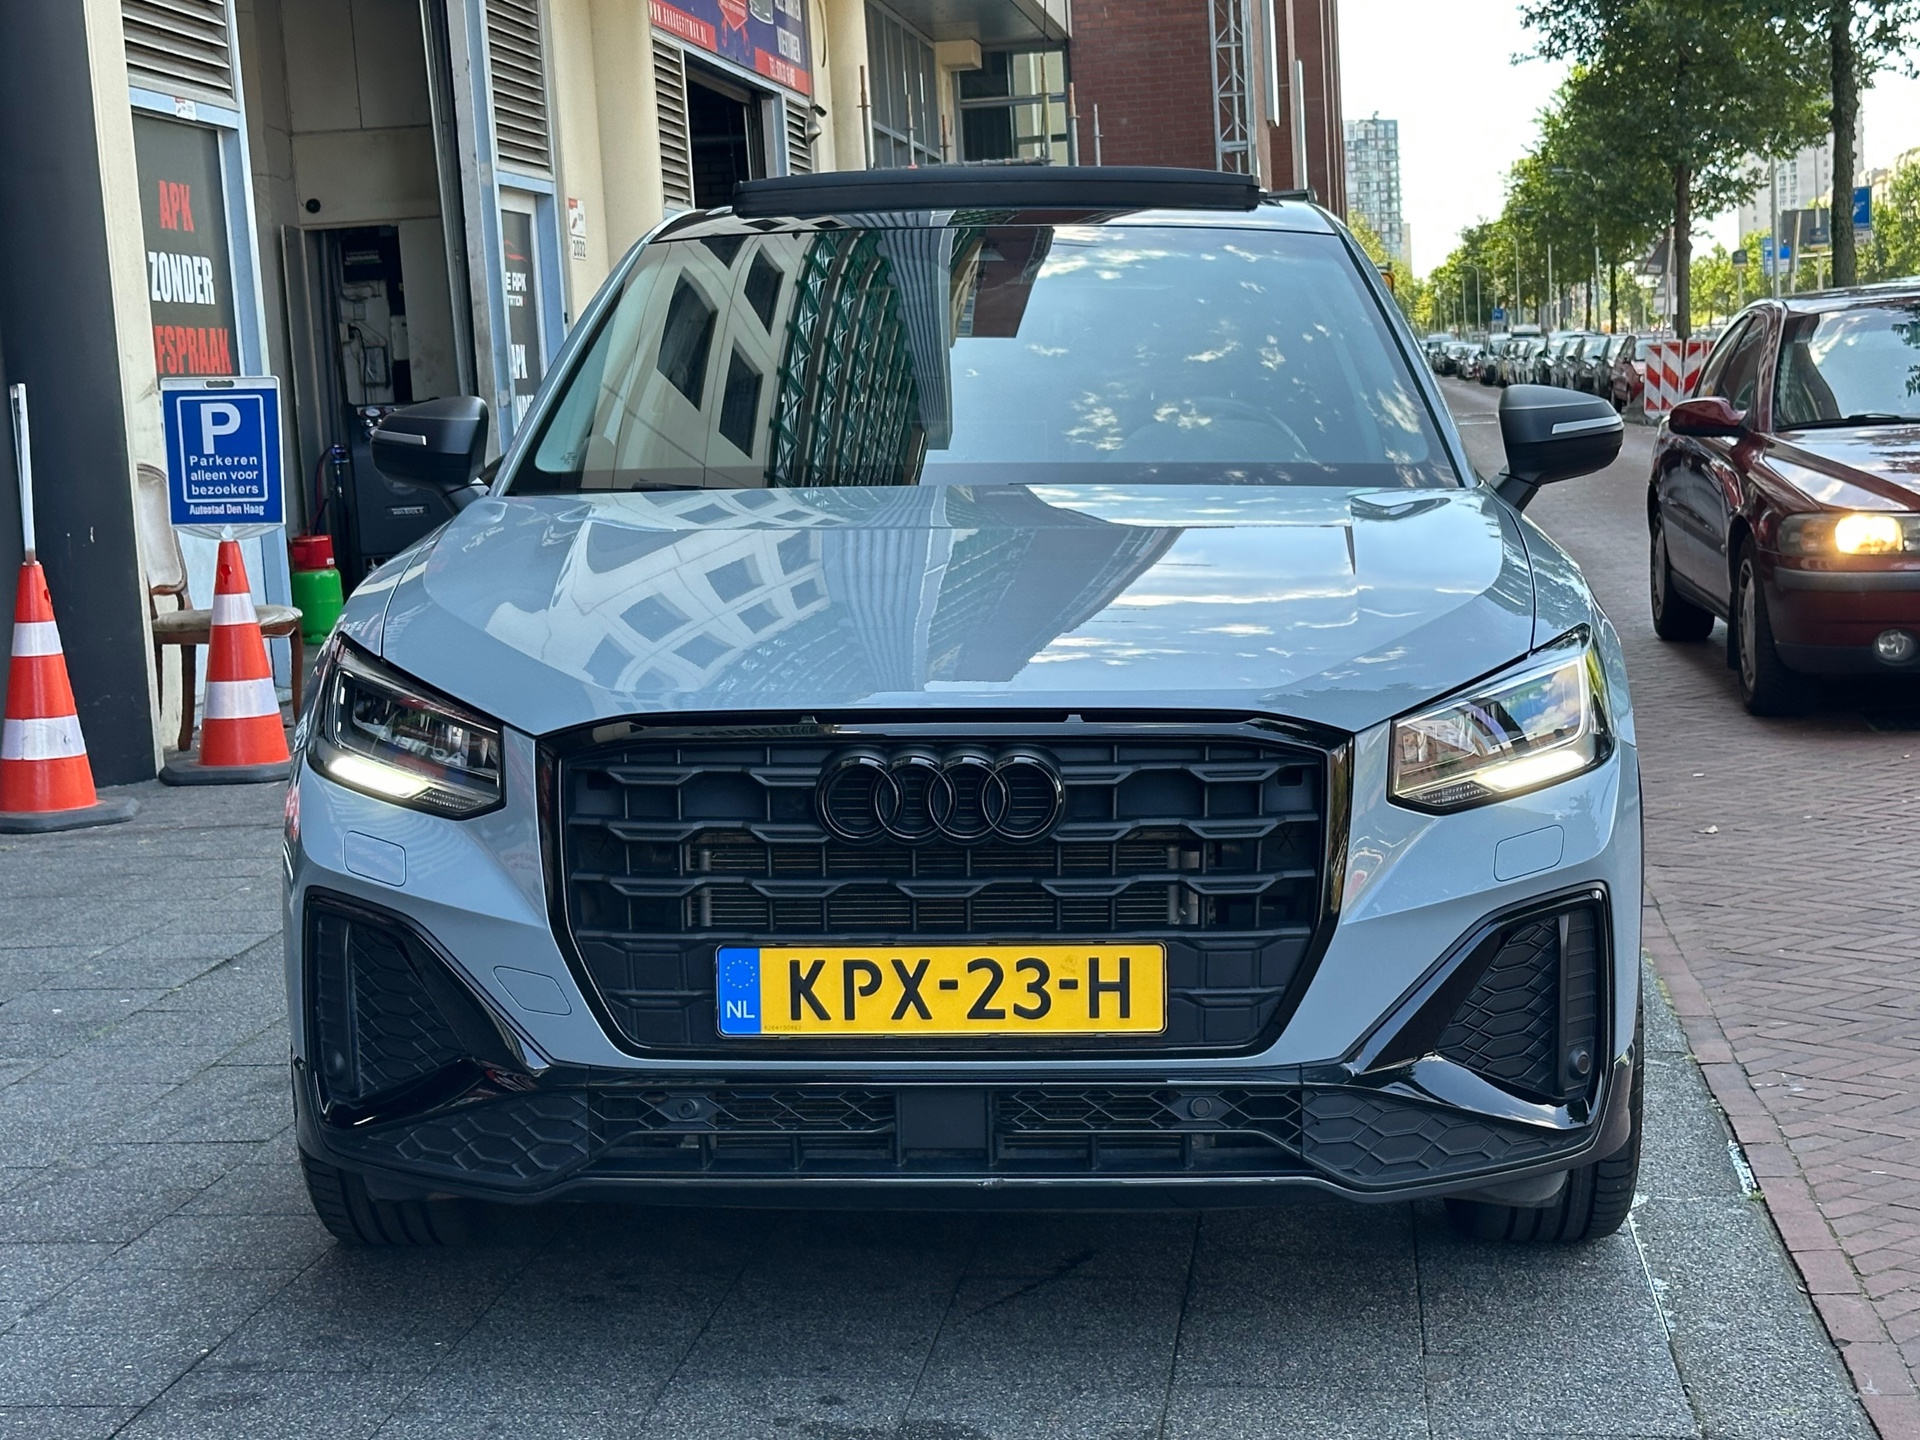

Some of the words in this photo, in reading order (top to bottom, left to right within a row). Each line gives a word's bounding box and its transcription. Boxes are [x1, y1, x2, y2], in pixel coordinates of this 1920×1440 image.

[159, 180, 194, 232] APK
[148, 251, 216, 305] ZONDER
[200, 402, 241, 455] P
[189, 455, 258, 466] Parkeren
[190, 469, 227, 481] alleen
[230, 470, 259, 480] voor
[191, 483, 259, 496] bezoekers
[189, 504, 225, 516] Autostad
[226, 504, 242, 514] Den
[243, 504, 265, 516] Haag
[789, 957, 1131, 1021] KPX-23-H
[726, 1000, 756, 1019] NL
